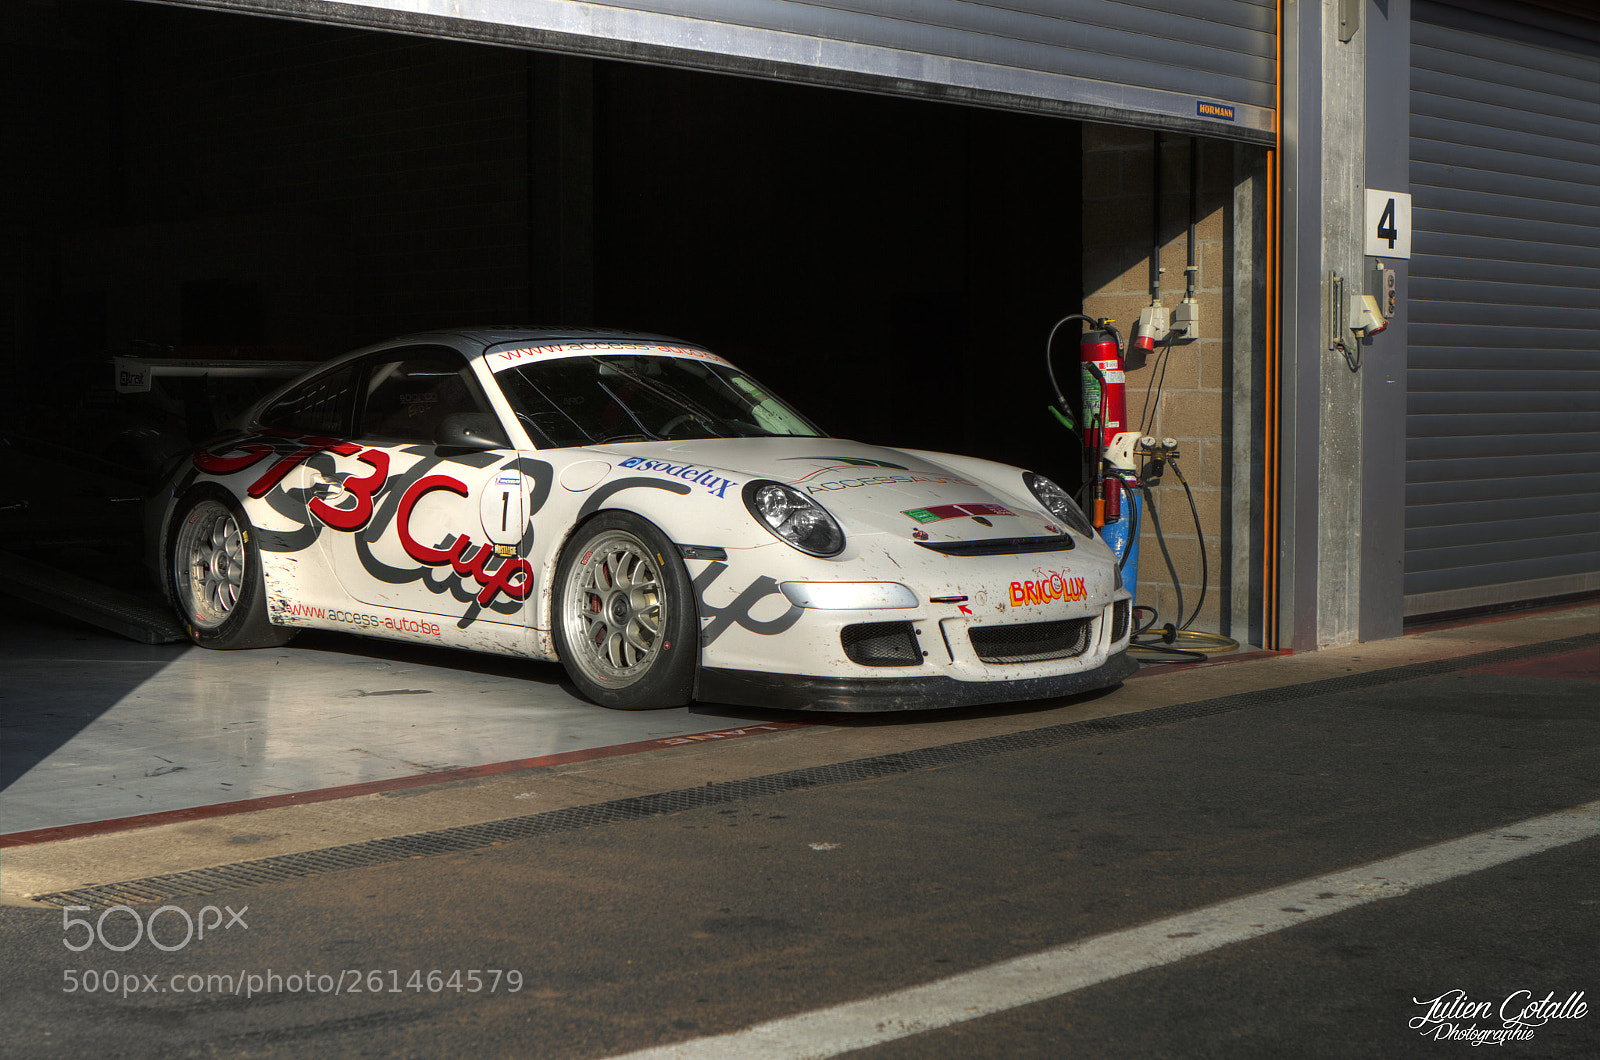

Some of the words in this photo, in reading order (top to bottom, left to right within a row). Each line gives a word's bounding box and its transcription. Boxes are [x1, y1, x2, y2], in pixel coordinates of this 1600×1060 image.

[1377, 198, 1397, 249] 4
[192, 428, 391, 533] GT3
[501, 491, 510, 532] 1
[397, 474, 535, 609] Cup
[1009, 573, 1088, 608] BRICOLUX
